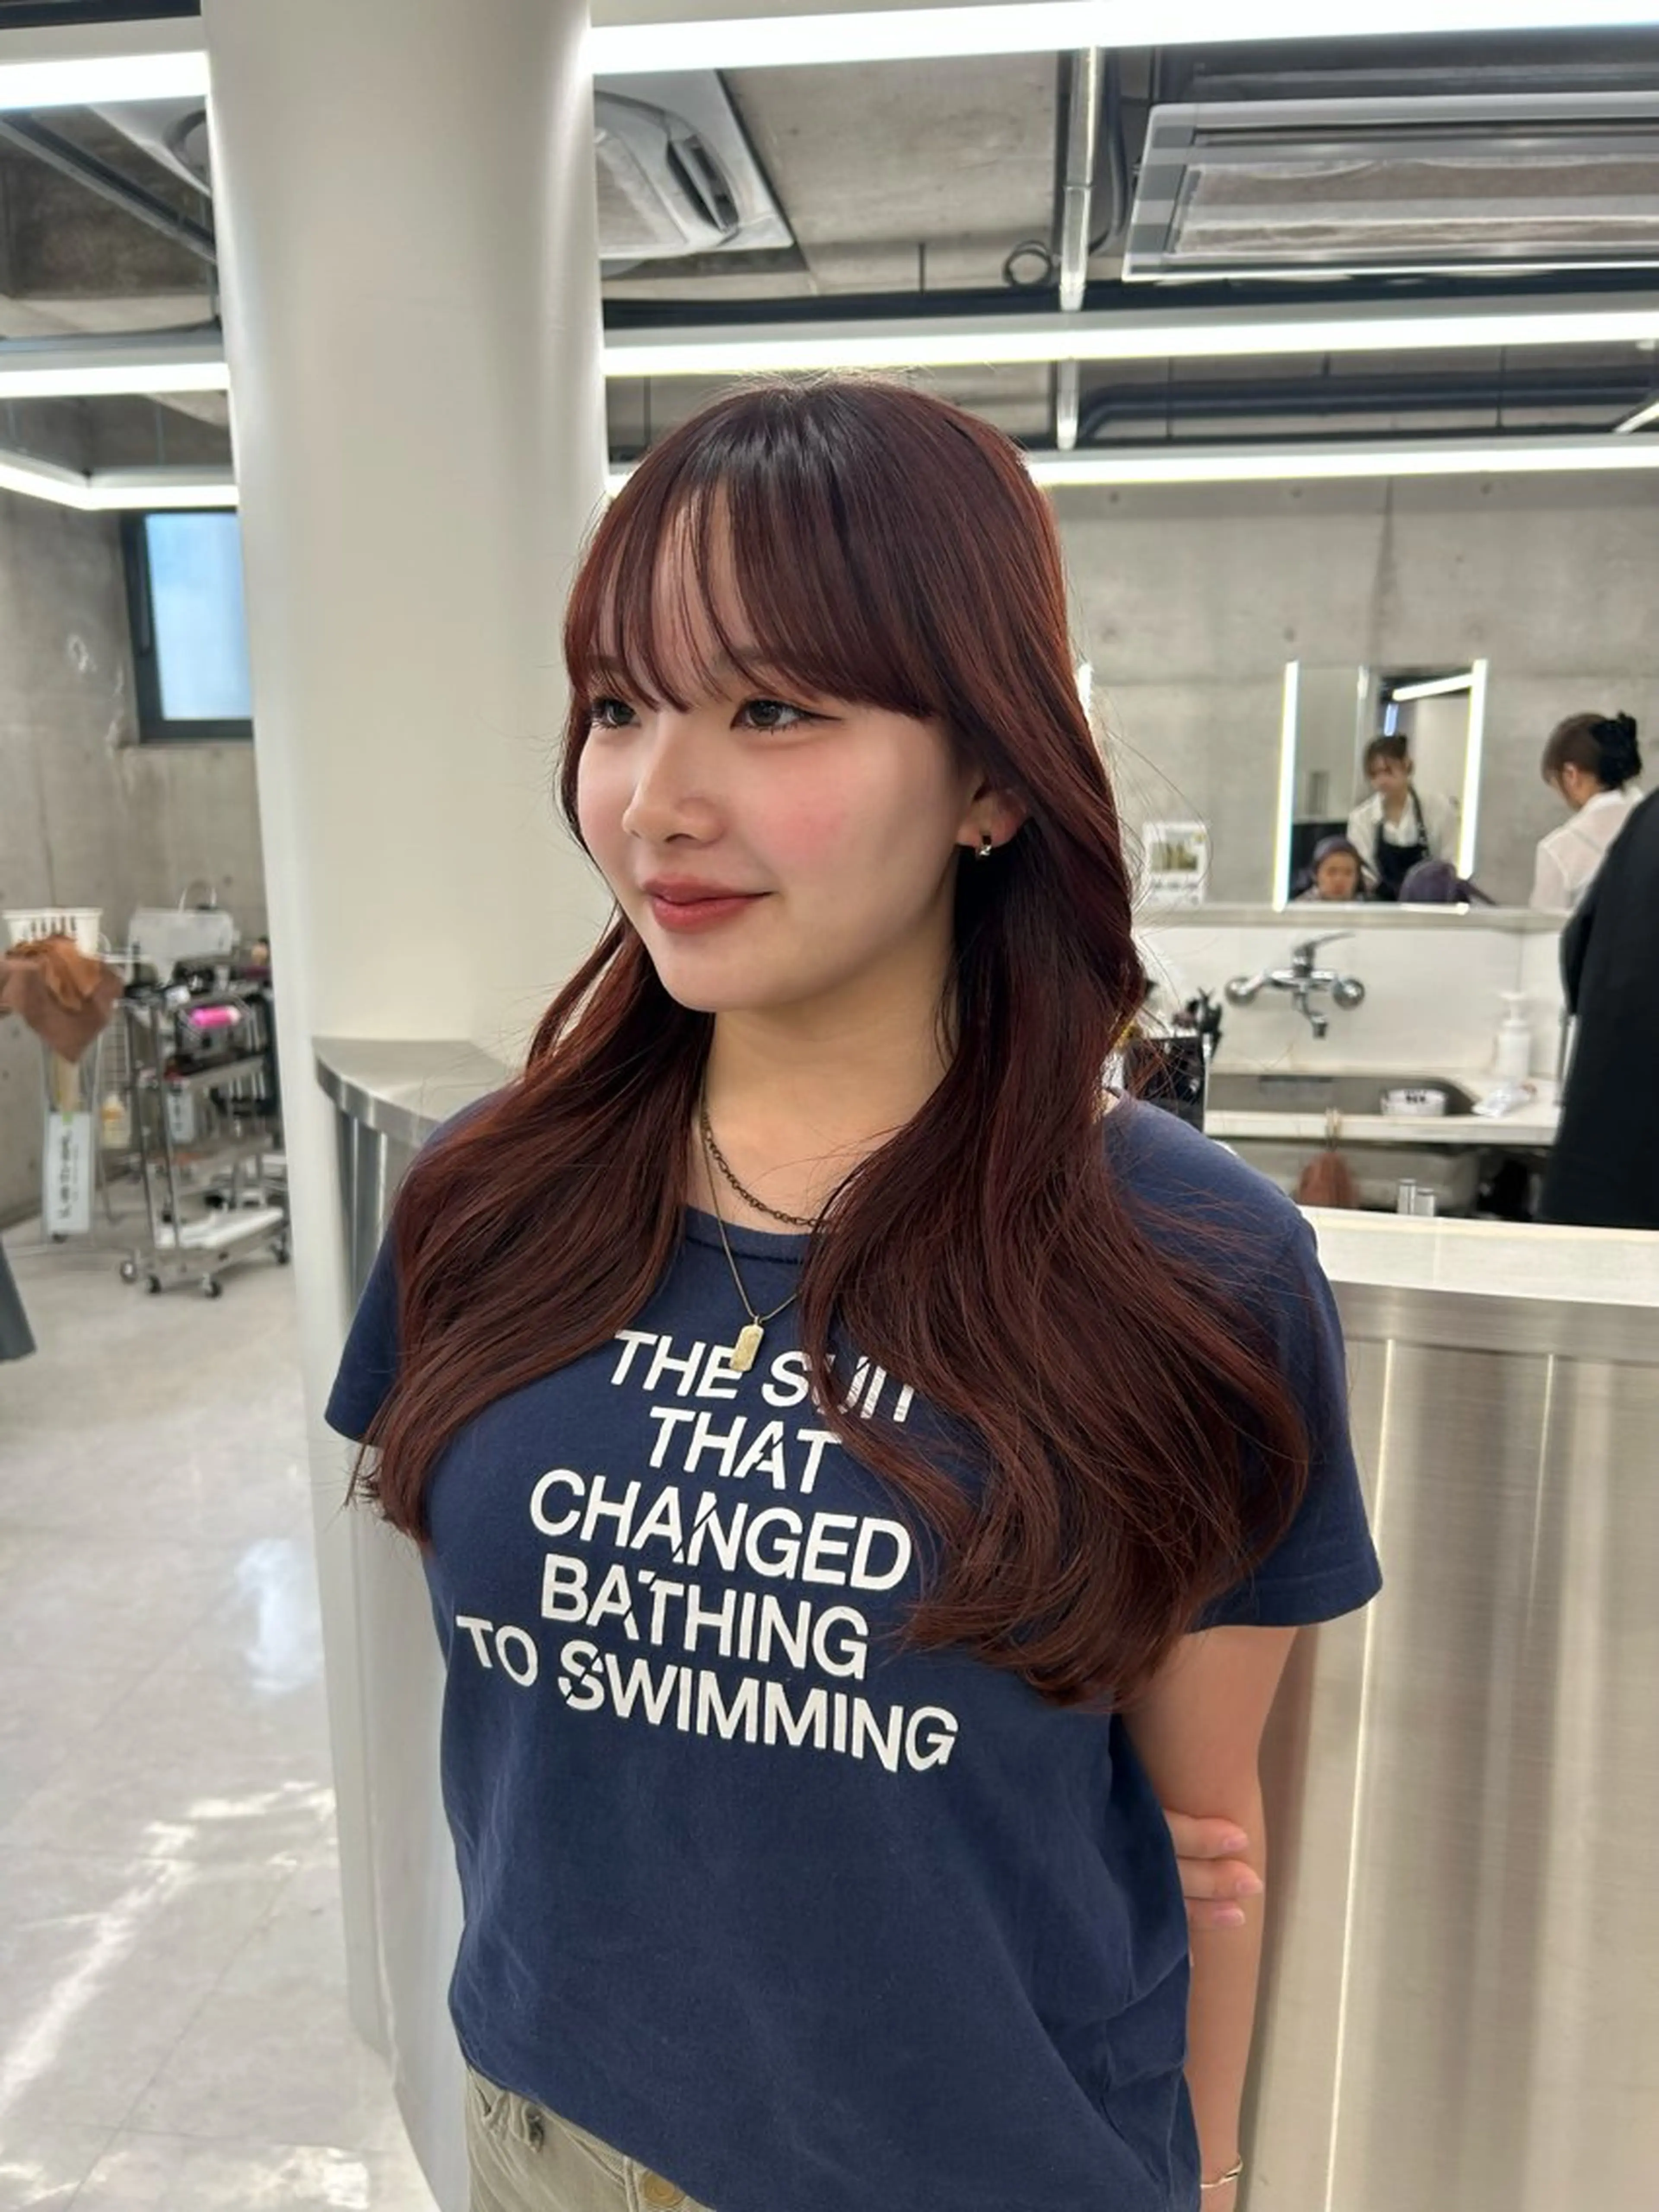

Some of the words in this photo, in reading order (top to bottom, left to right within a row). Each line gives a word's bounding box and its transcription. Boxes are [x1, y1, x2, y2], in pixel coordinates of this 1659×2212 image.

[610, 1329, 744, 1400] THE
[649, 1405, 842, 1494] THAT
[529, 1468, 912, 1591] CHANGED
[541, 1553, 869, 1681] BATHING
[455, 1615, 538, 1687] TO
[557, 1640, 959, 1773] SWIMMING
